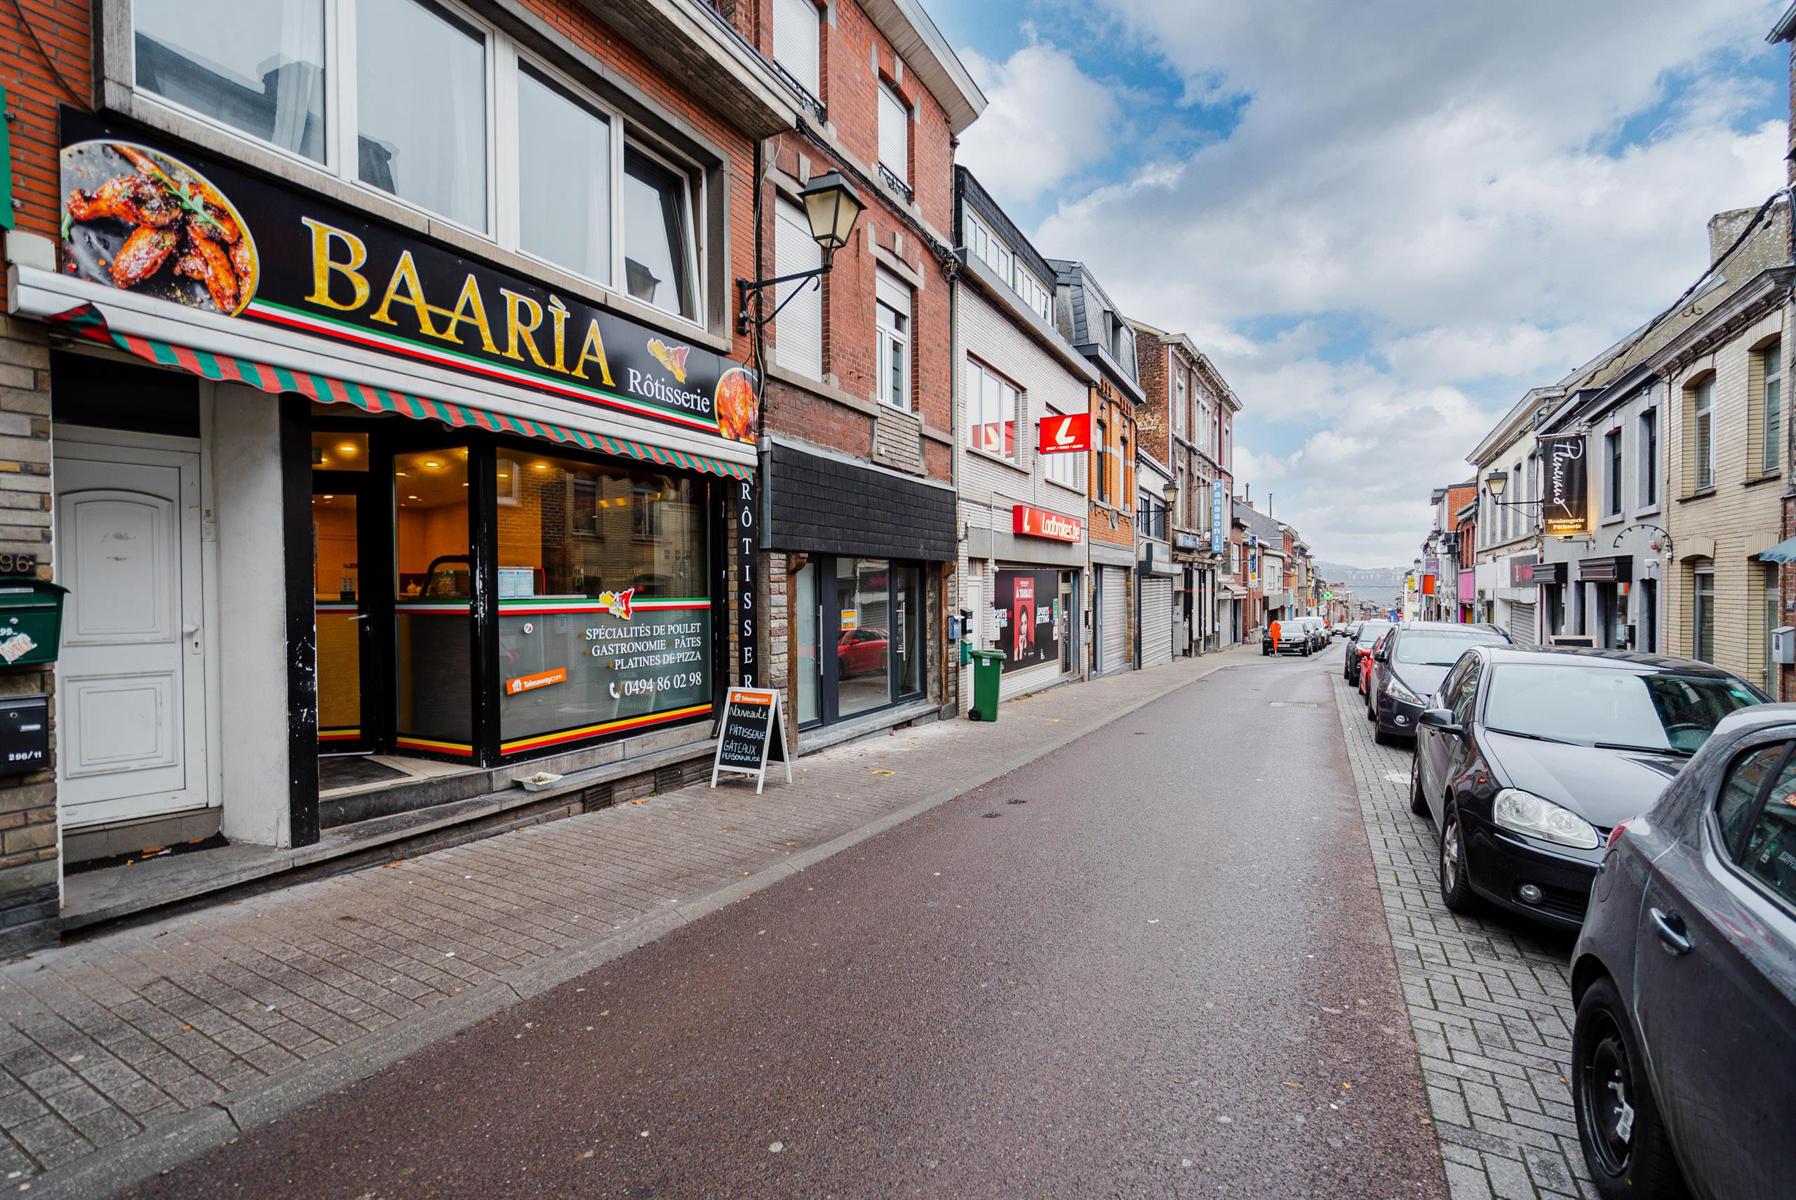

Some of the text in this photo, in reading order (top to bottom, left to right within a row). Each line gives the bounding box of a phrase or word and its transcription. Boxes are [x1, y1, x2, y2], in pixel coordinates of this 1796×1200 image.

[301, 215, 616, 388] BAARÌA
[627, 367, 711, 414] Rôtisserie
[1213, 482, 1221, 551] Panasonic
[585, 622, 702, 640] SPÉCIALITÉS DE POULET
[591, 635, 702, 657] GASTRONOMIE PÂTES
[614, 651, 702, 670] PLATINES DE PIZZA
[624, 671, 702, 696] 0494 86 02 98
